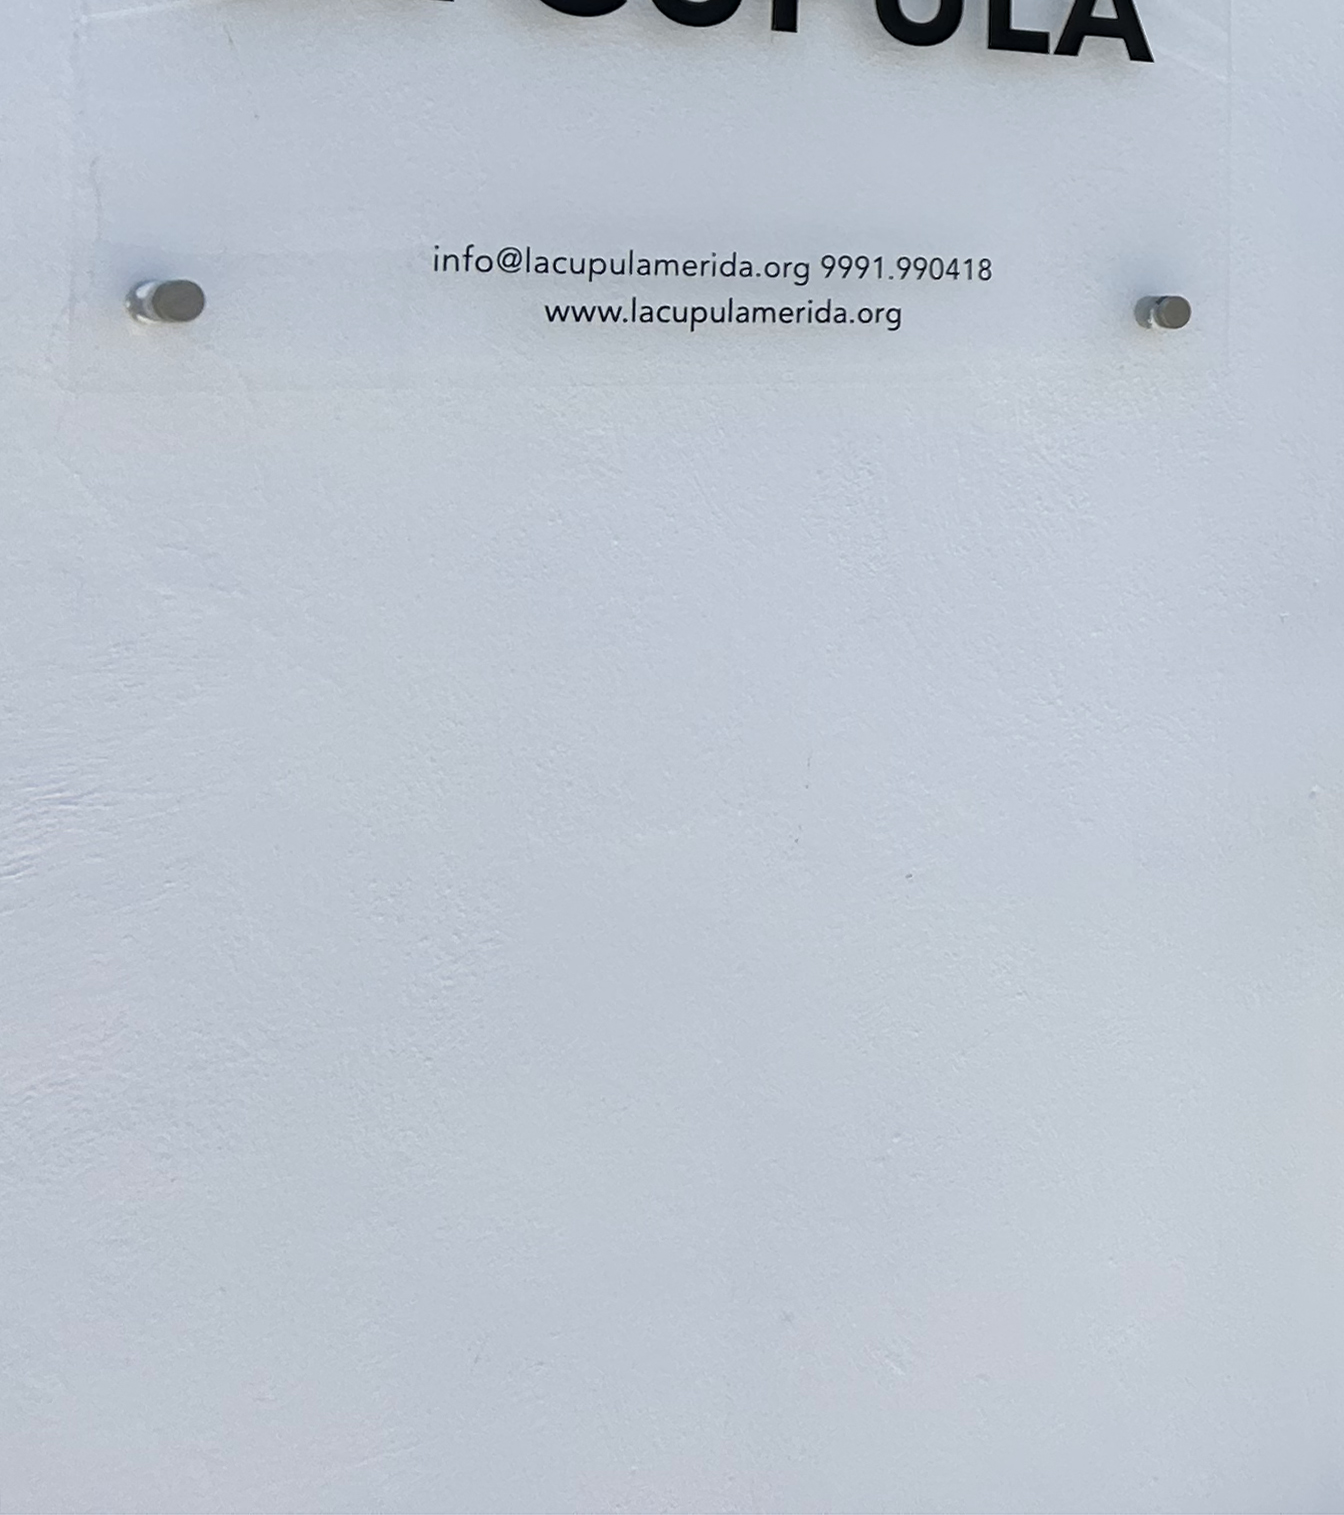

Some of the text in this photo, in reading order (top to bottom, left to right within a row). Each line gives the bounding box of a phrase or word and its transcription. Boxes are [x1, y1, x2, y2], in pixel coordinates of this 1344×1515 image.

[432, 244, 994, 287] info@lacupulamerida.org 9991.990418
[544, 297, 903, 333] www.lacupulamerida.org
